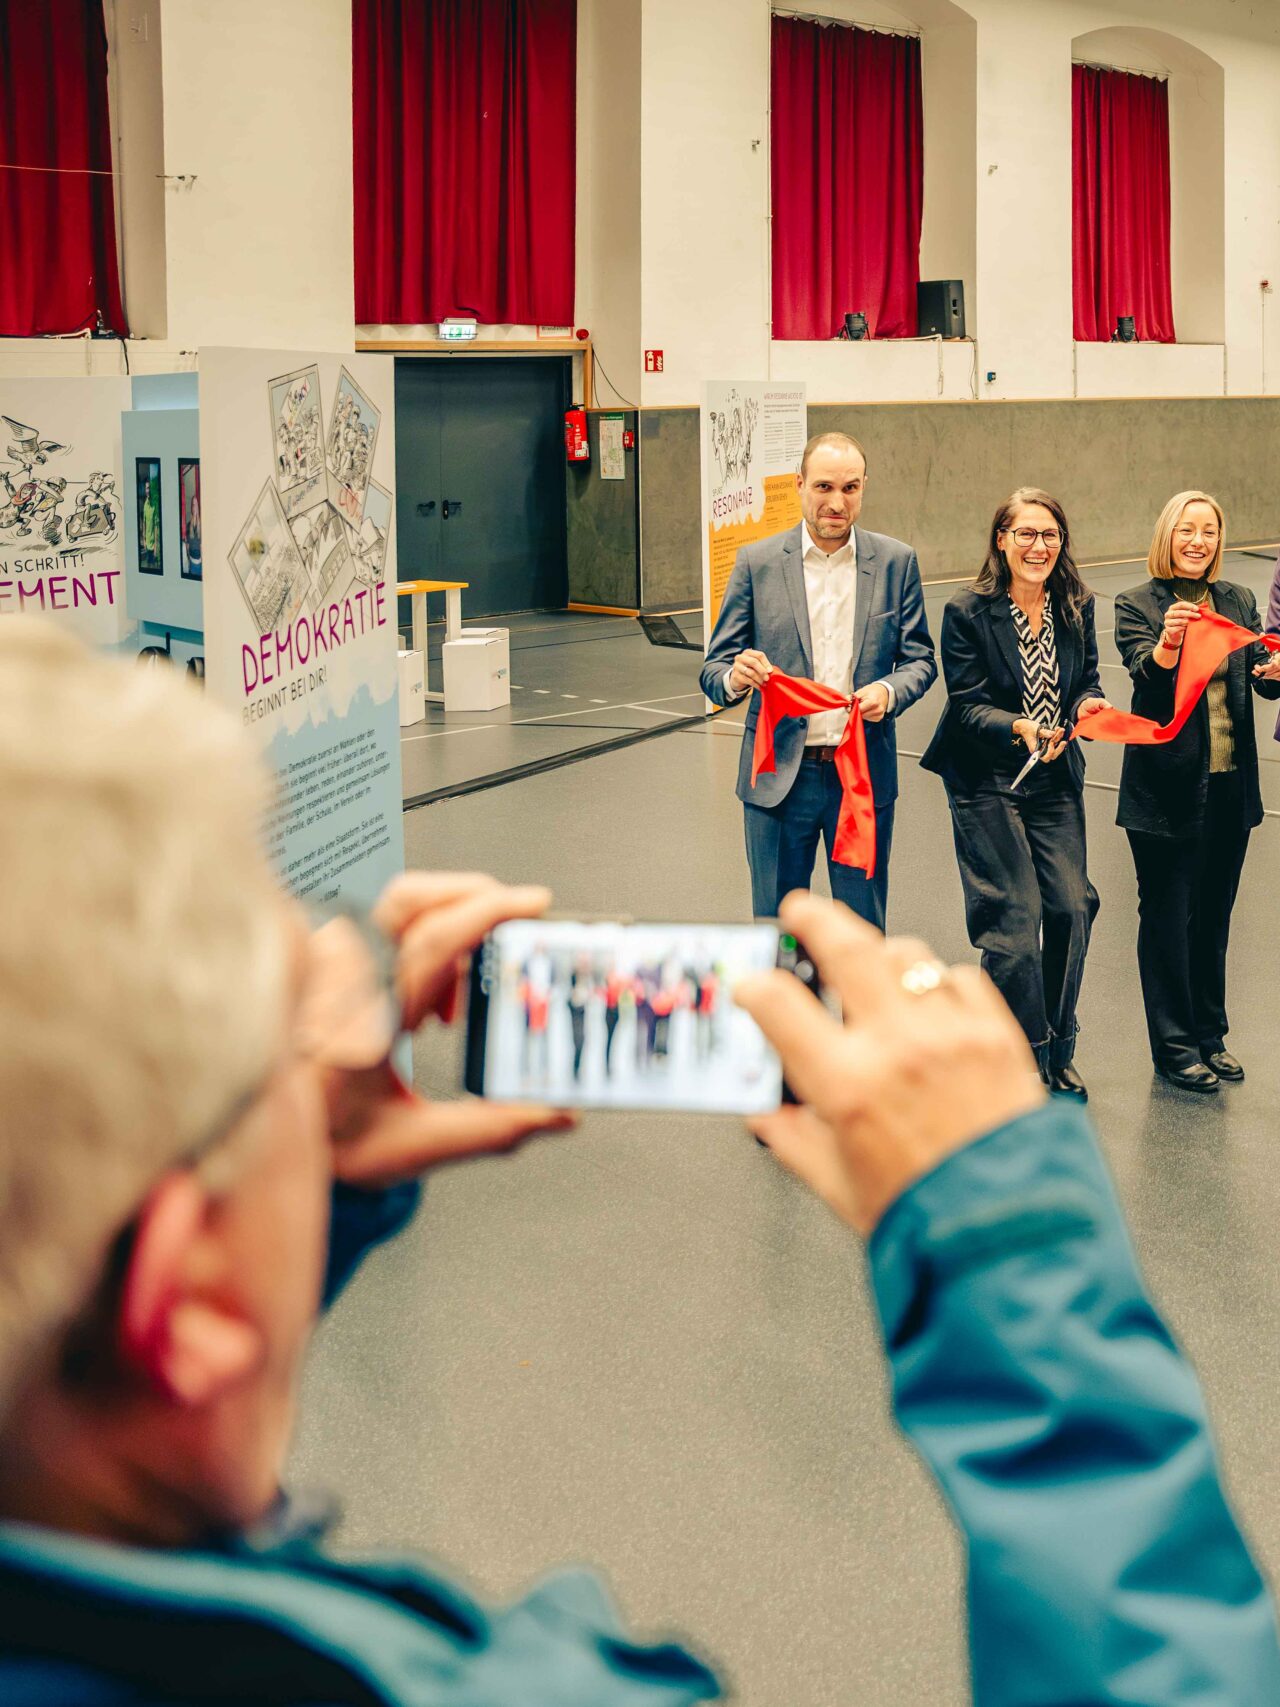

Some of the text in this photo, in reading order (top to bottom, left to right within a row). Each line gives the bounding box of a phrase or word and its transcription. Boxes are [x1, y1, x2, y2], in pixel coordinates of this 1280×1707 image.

[712, 486, 752, 520] RESONANZ
[0, 554, 85, 574] N SCHRITT!
[0, 571, 120, 614] EMENT
[242, 582, 386, 697] DEMOKRATIE
[243, 664, 327, 727] BEGINNT BEI DIR!
[288, 754, 317, 774] Demokratie
